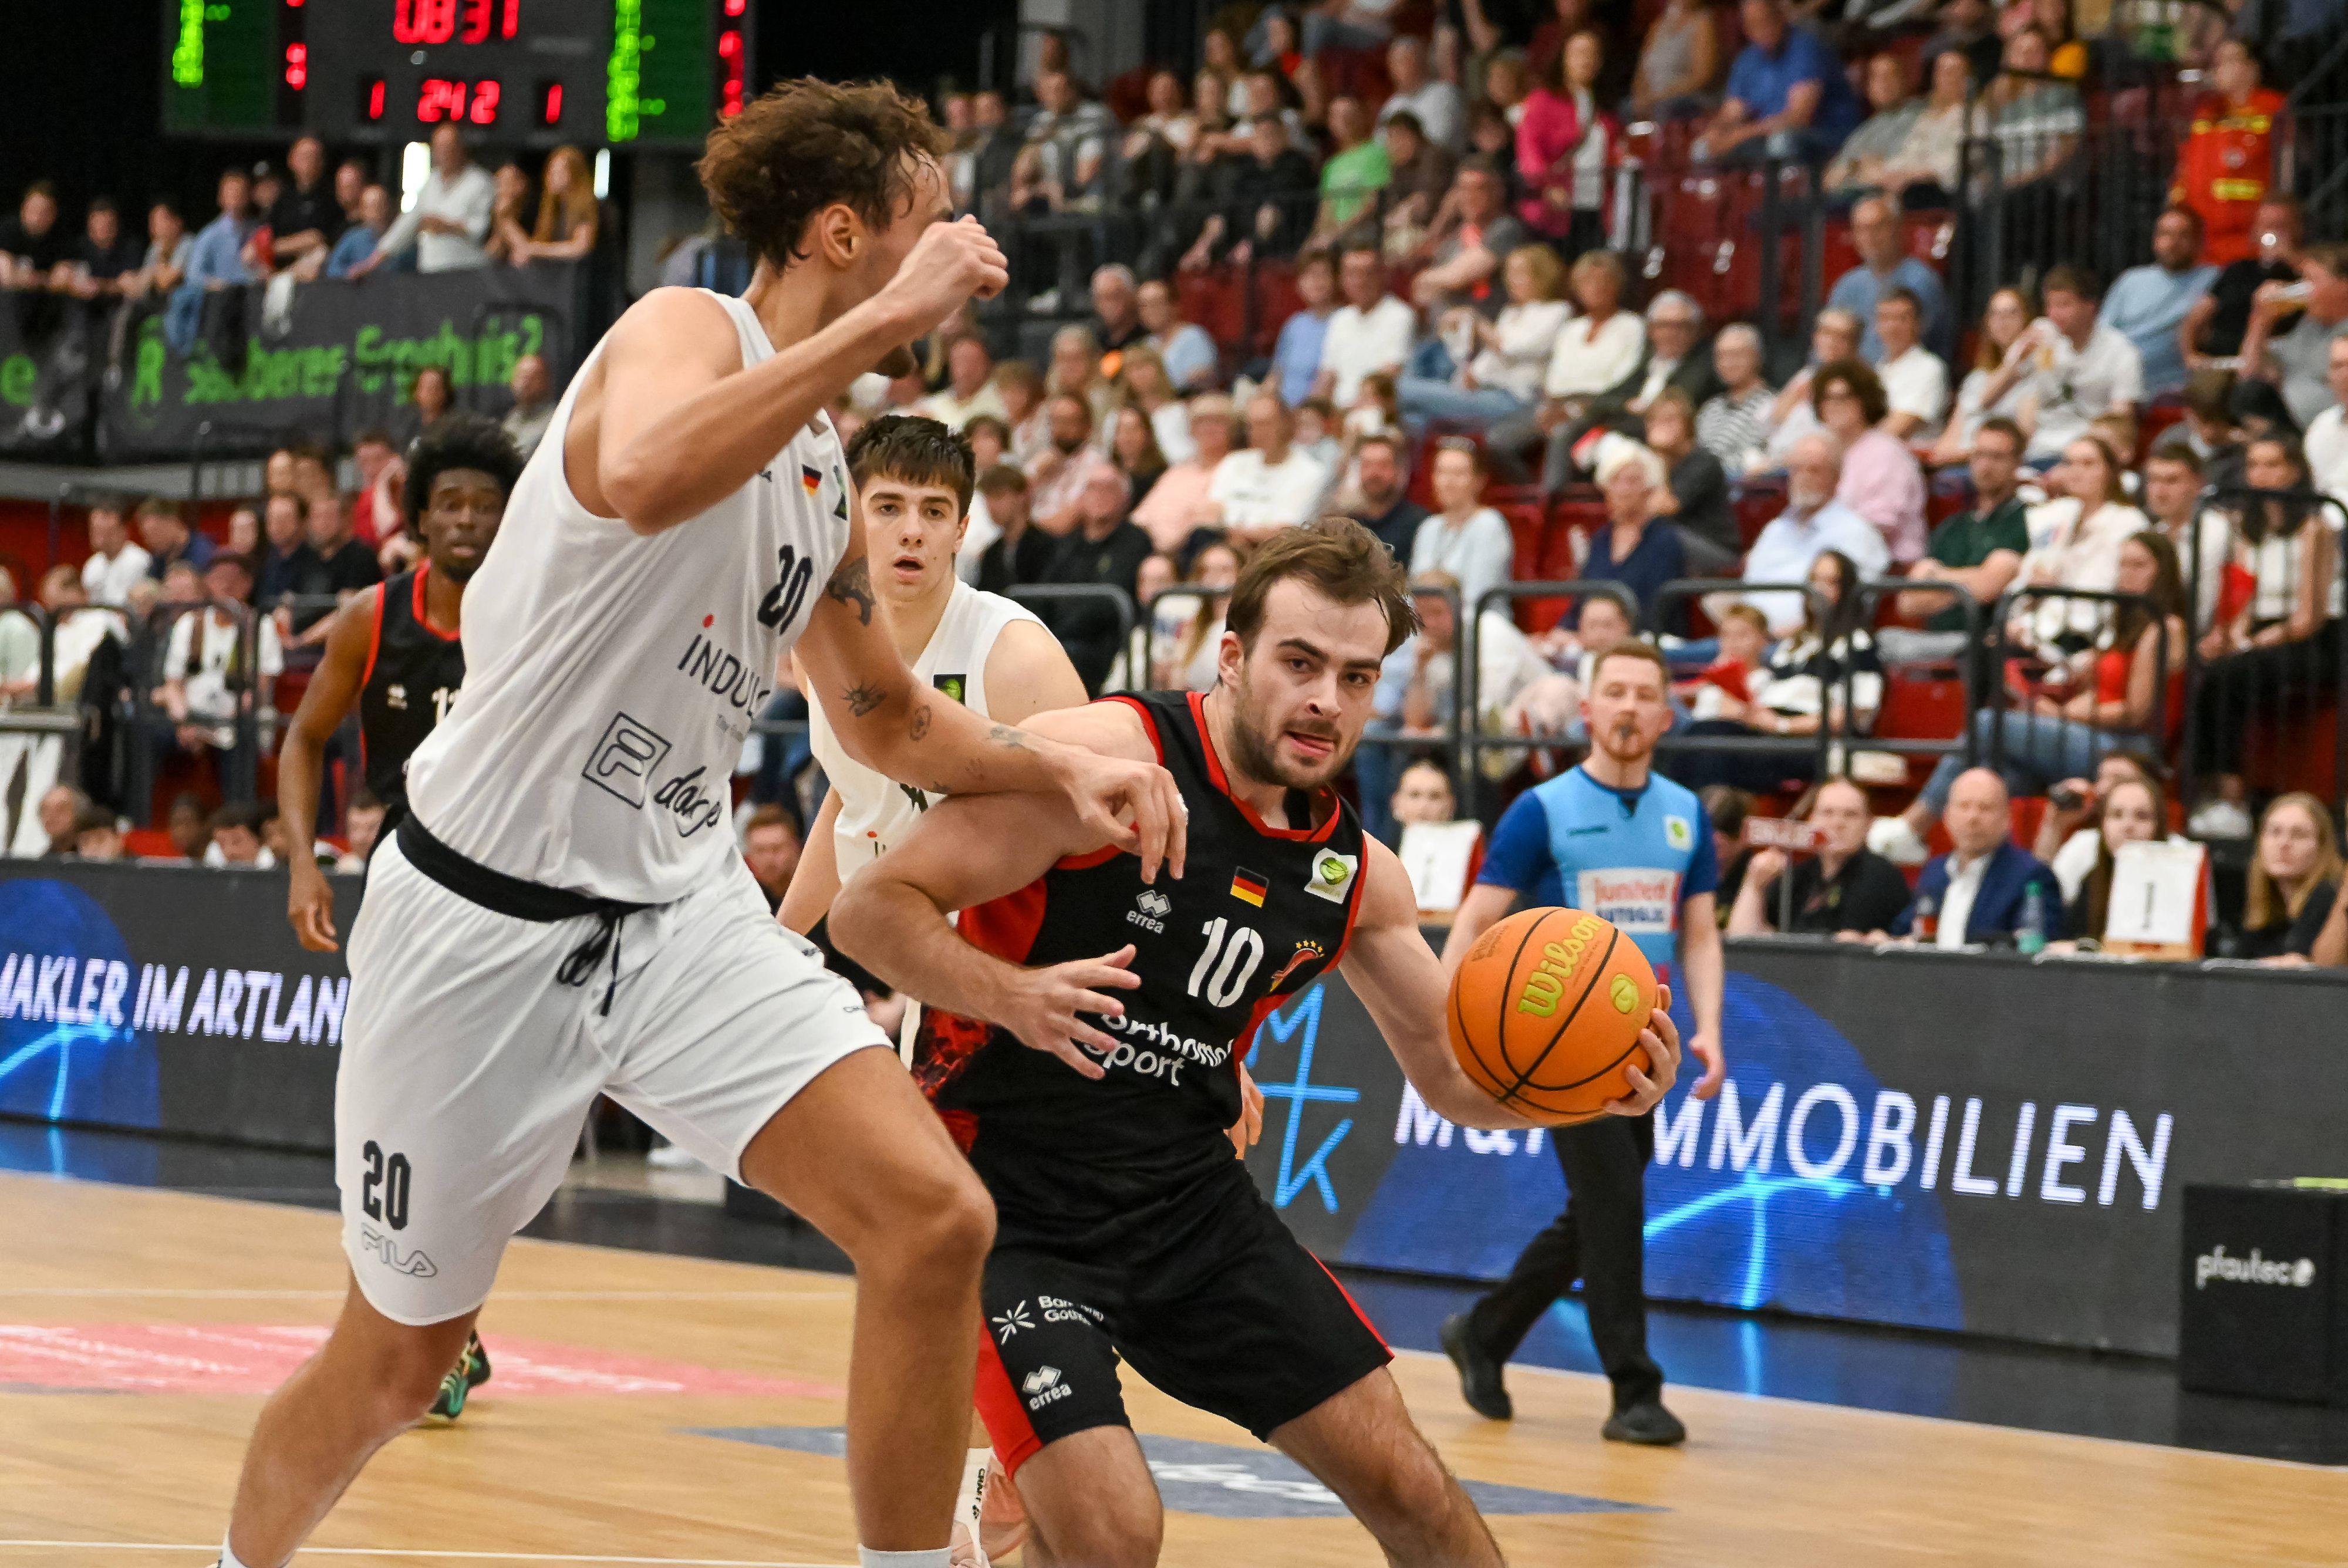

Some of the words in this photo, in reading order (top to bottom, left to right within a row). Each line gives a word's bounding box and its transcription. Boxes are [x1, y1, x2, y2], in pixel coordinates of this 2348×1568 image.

[757, 542, 813, 636] 20
[1126, 909, 1165, 935] errea
[1187, 916, 1264, 1007] 10
[132, 963, 190, 1034] IM
[1517, 915, 1604, 1017] Wilson
[362, 1139, 412, 1231] 20
[360, 1222, 438, 1278] FILA
[1028, 1383, 1072, 1411] errea
